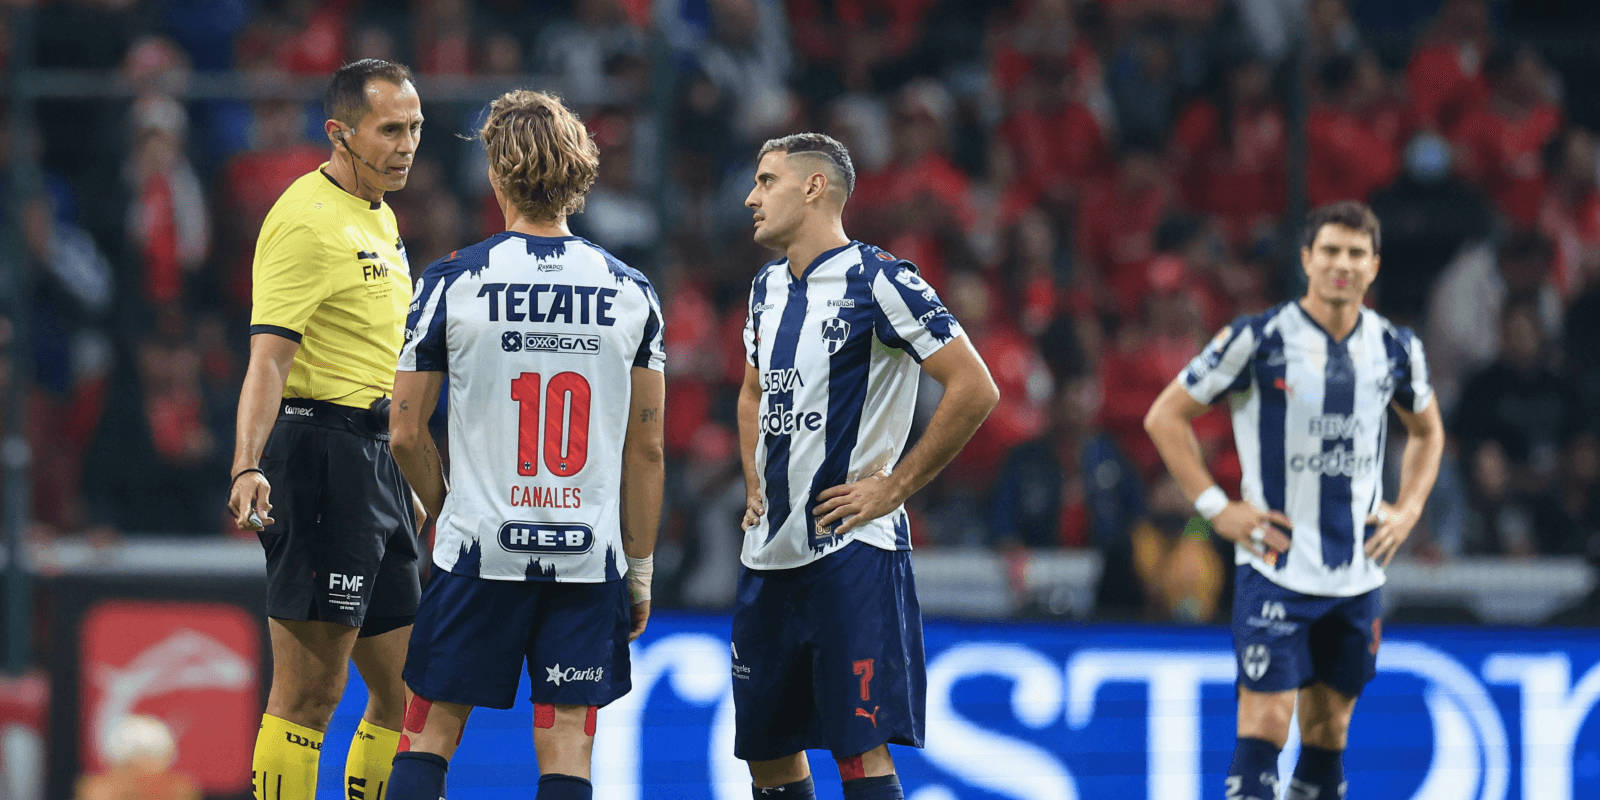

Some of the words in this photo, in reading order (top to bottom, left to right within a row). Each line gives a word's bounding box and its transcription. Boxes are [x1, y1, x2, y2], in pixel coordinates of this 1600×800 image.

[476, 283, 618, 326] TECATE
[511, 371, 591, 477] 10
[511, 485, 581, 508] CANALES
[509, 528, 585, 547] H-E-B
[328, 572, 364, 592] FMF
[563, 666, 595, 682] Carl's
[852, 658, 874, 701] 7
